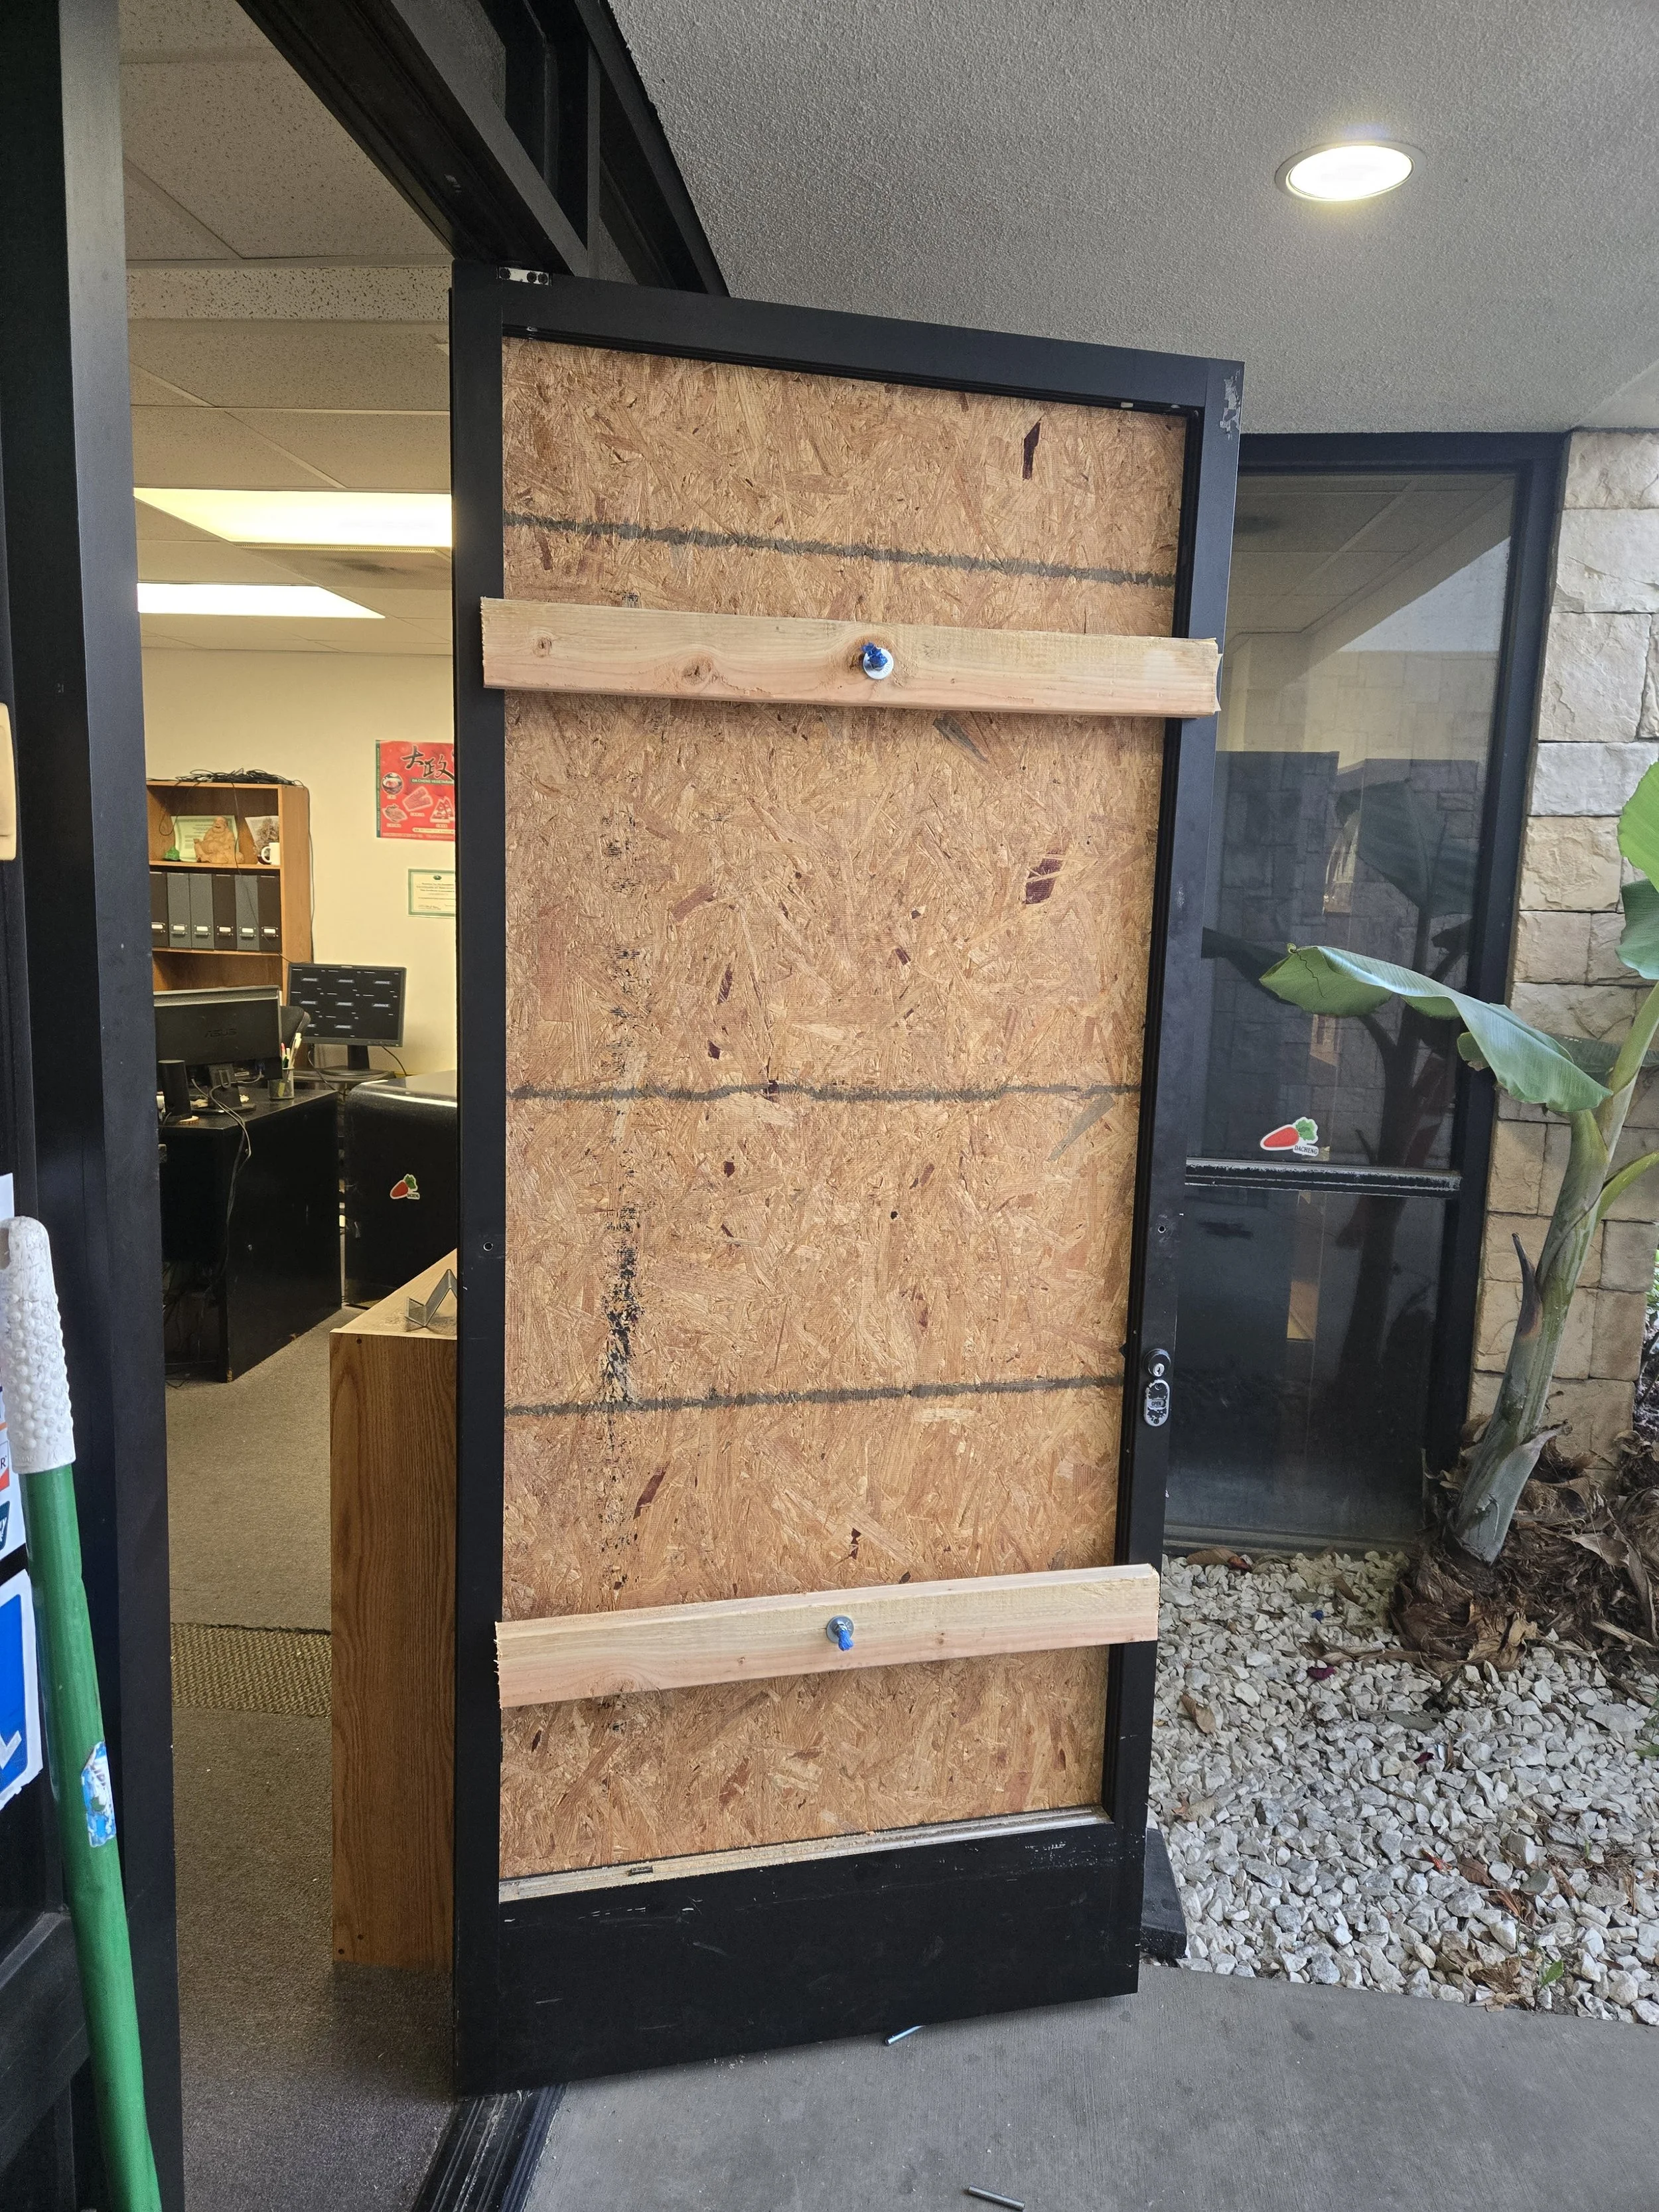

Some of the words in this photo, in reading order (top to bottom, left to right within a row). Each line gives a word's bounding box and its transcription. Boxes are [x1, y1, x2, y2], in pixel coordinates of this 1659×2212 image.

[401, 745, 454, 780] 大政
[204, 1028, 238, 1038] ASUS
[1294, 1145, 1318, 1155] DACHENG
